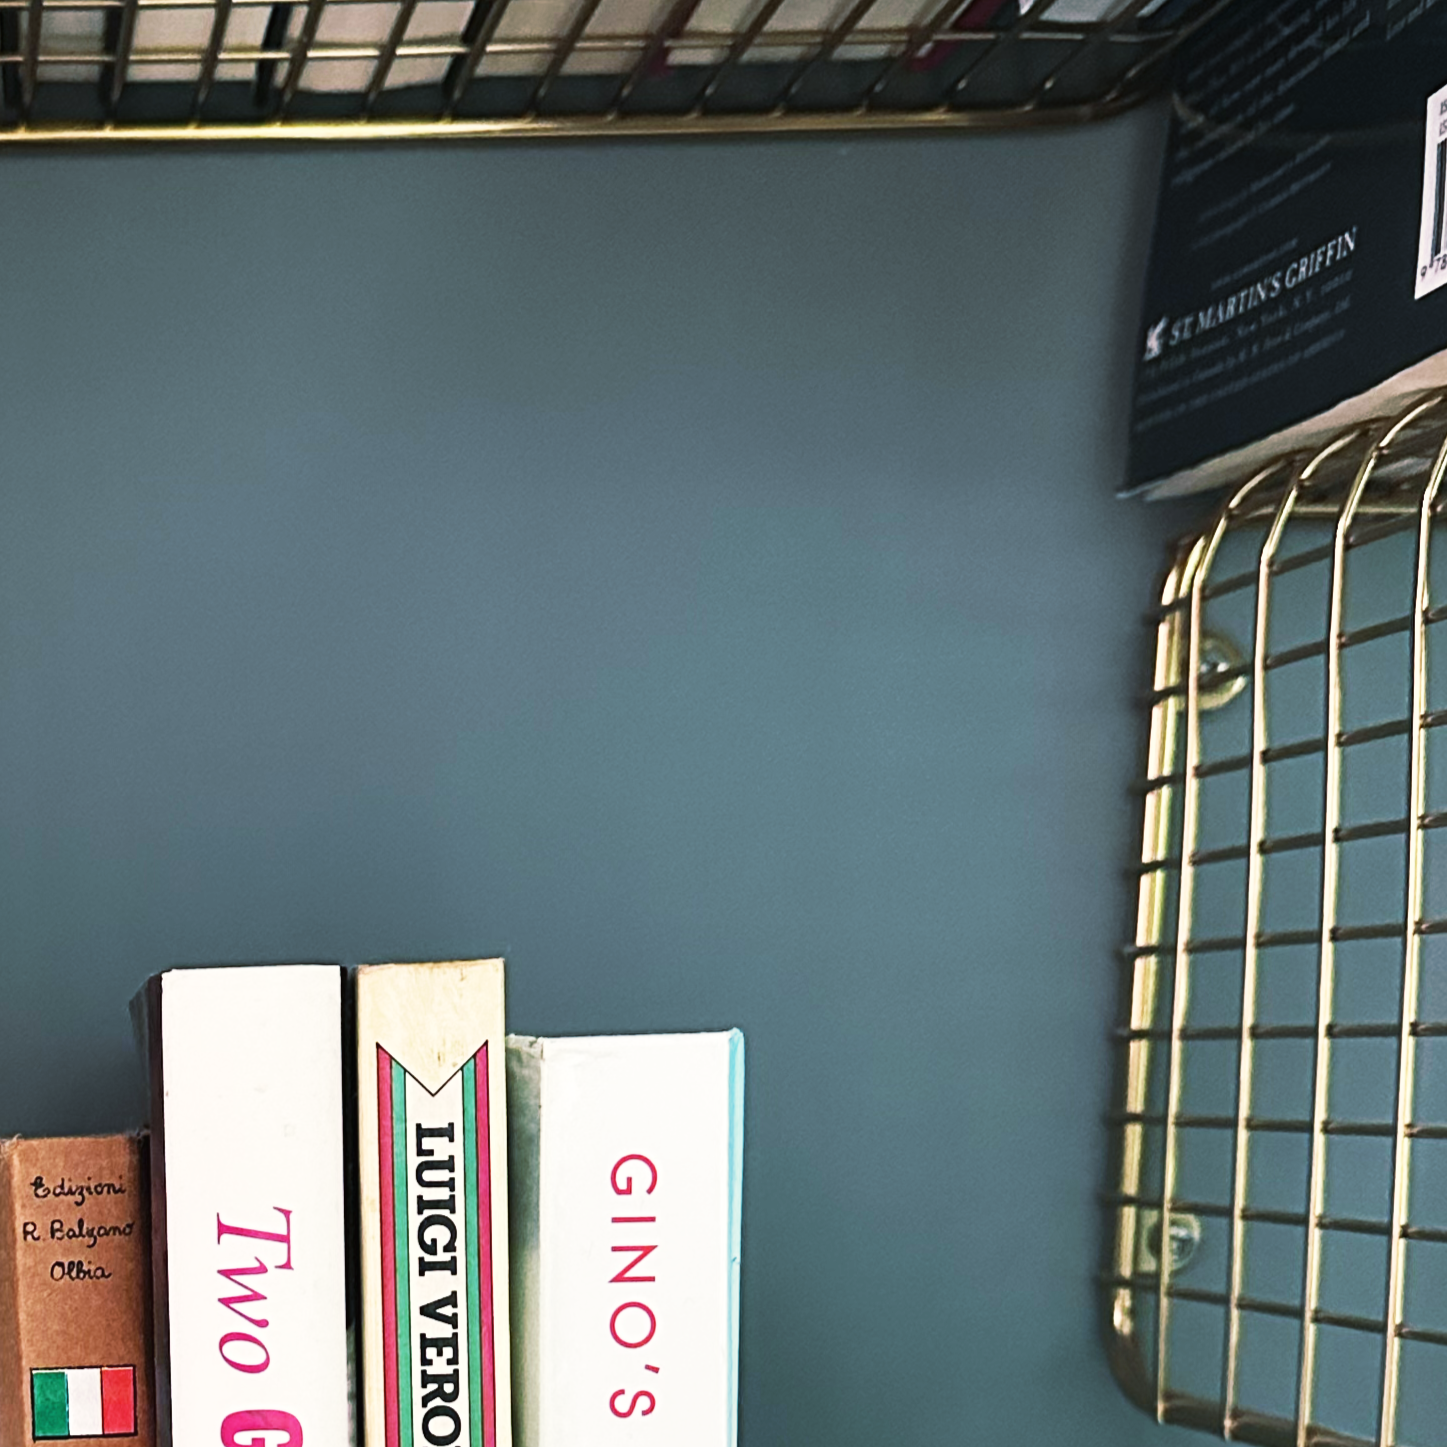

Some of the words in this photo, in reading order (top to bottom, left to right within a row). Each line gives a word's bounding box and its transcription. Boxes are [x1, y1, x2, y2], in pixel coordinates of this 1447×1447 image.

[1196, 270, 1282, 335] MARTIN'S
[1285, 226, 1357, 289] GRIFFIN
[30, 1174, 126, 1206] Edizioni
[415, 1122, 458, 1277] LUIGI
[50, 1260, 112, 1281] Olbia
[216, 1206, 294, 1374] Two
[609, 1154, 659, 1419] GINO'S
